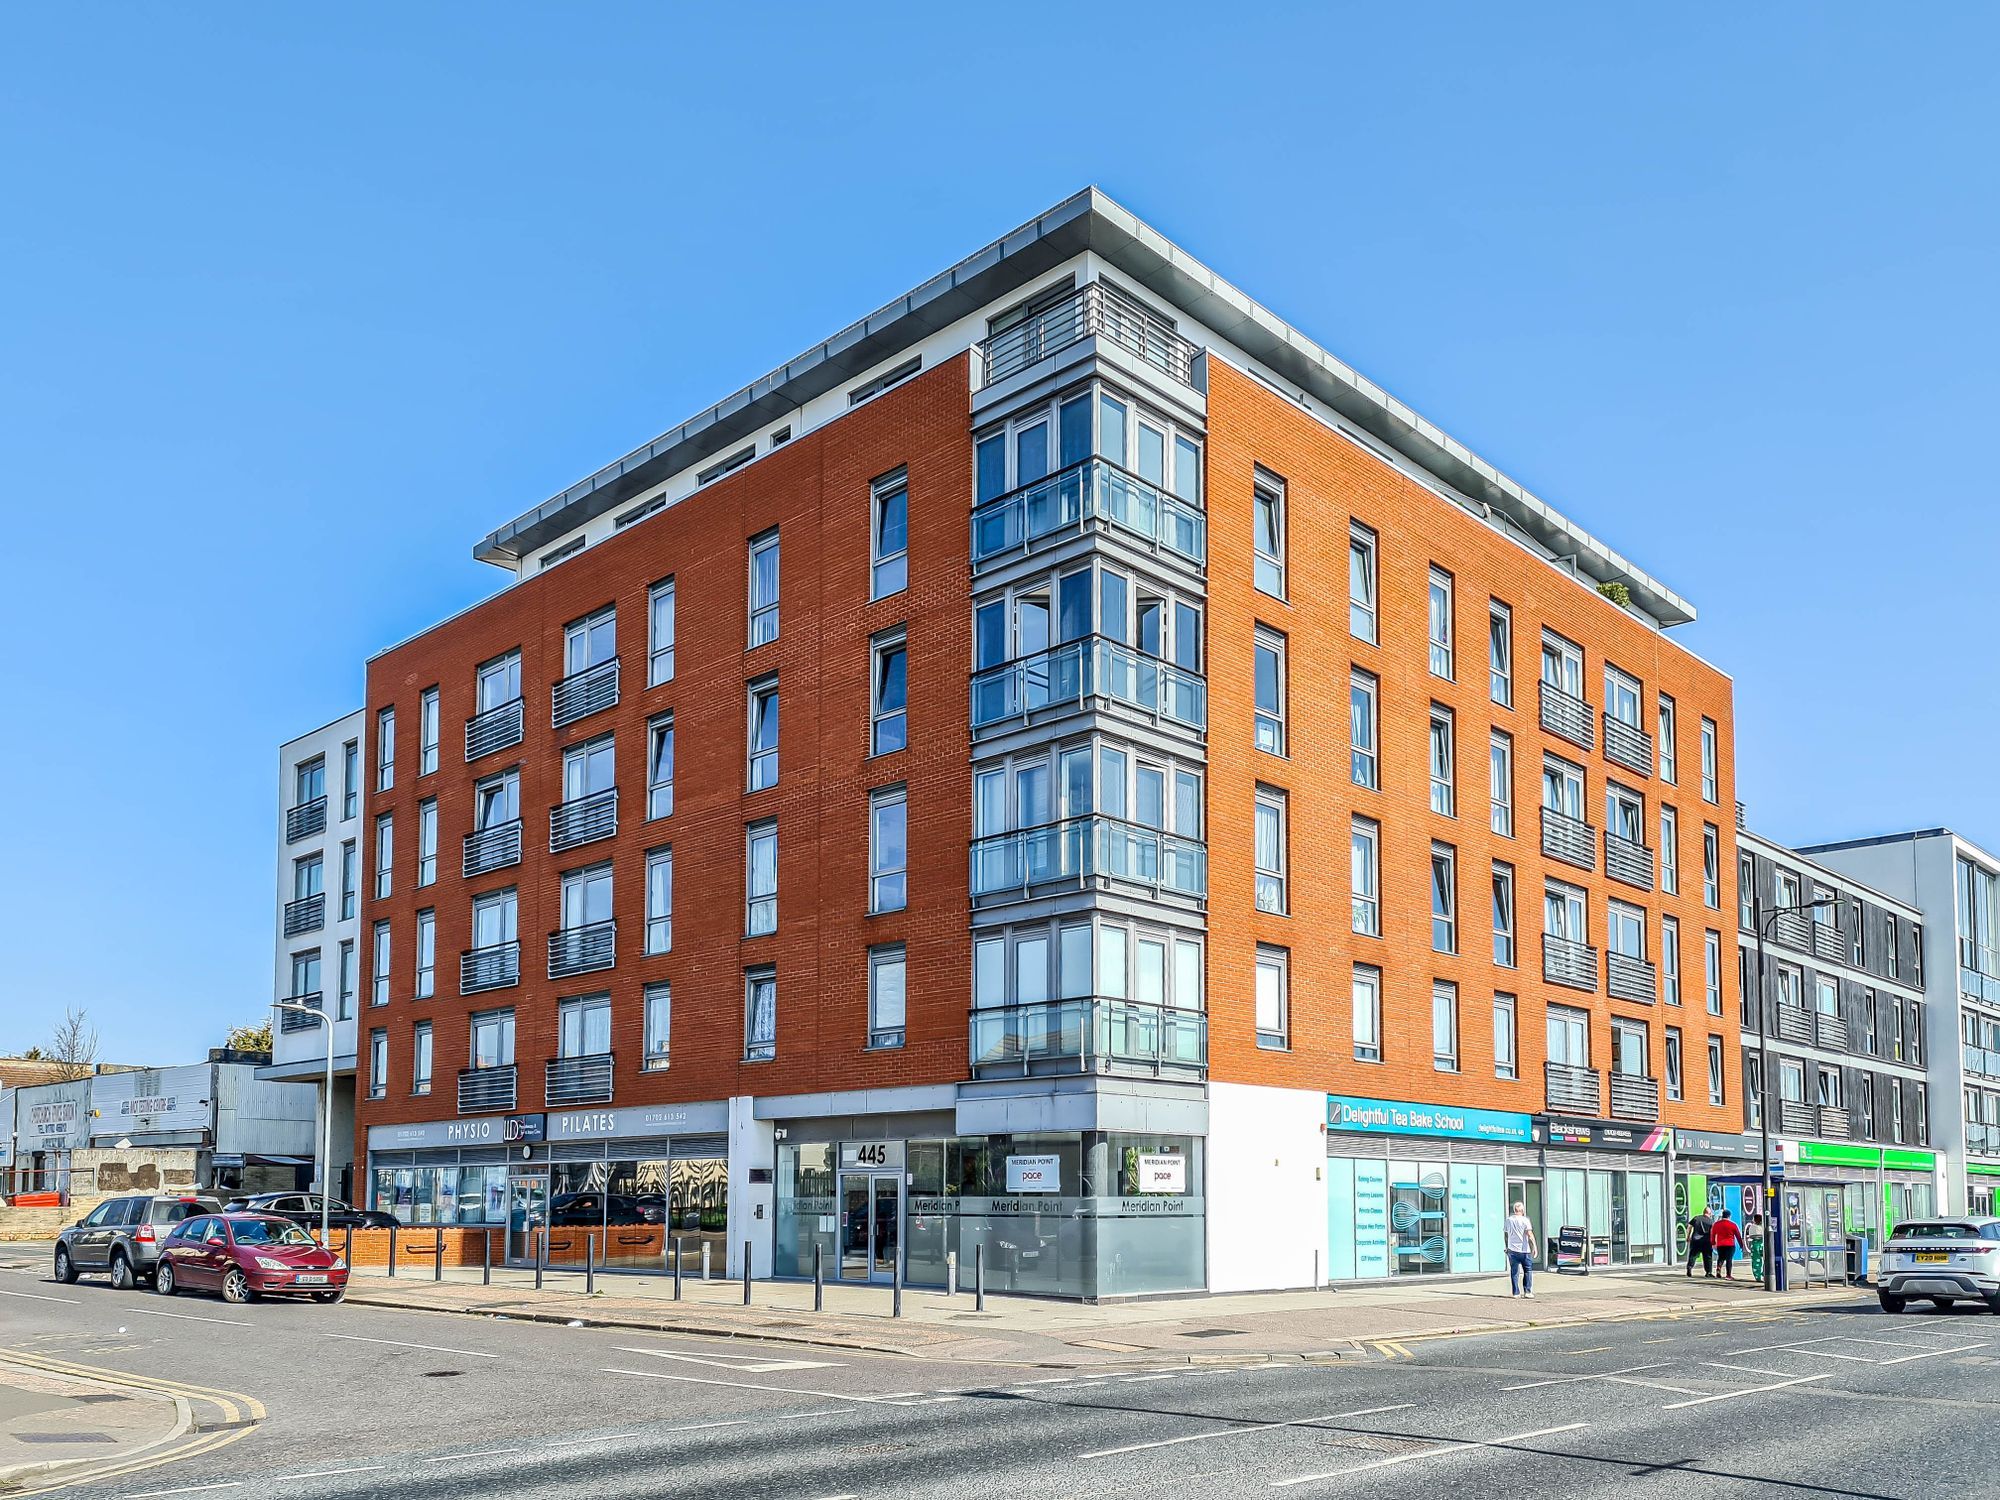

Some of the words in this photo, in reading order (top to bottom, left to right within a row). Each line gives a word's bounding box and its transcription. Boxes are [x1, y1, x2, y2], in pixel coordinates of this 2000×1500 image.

[562, 1113, 615, 1133] PILATES
[1343, 1105, 1389, 1127] Delightful
[1390, 1109, 1408, 1126] Tea
[1410, 1110, 1433, 1128] Bake
[1434, 1112, 1464, 1131] School
[448, 1122, 490, 1140] PHYSIO
[857, 1145, 886, 1164] 445
[1011, 1158, 1037, 1166] MERIDIAN
[914, 1200, 952, 1211] Meridian
[992, 1200, 1034, 1212] Meridian
[1038, 1200, 1063, 1212] Point
[1122, 1200, 1161, 1212] Meridian
[1163, 1200, 1184, 1212] Point
